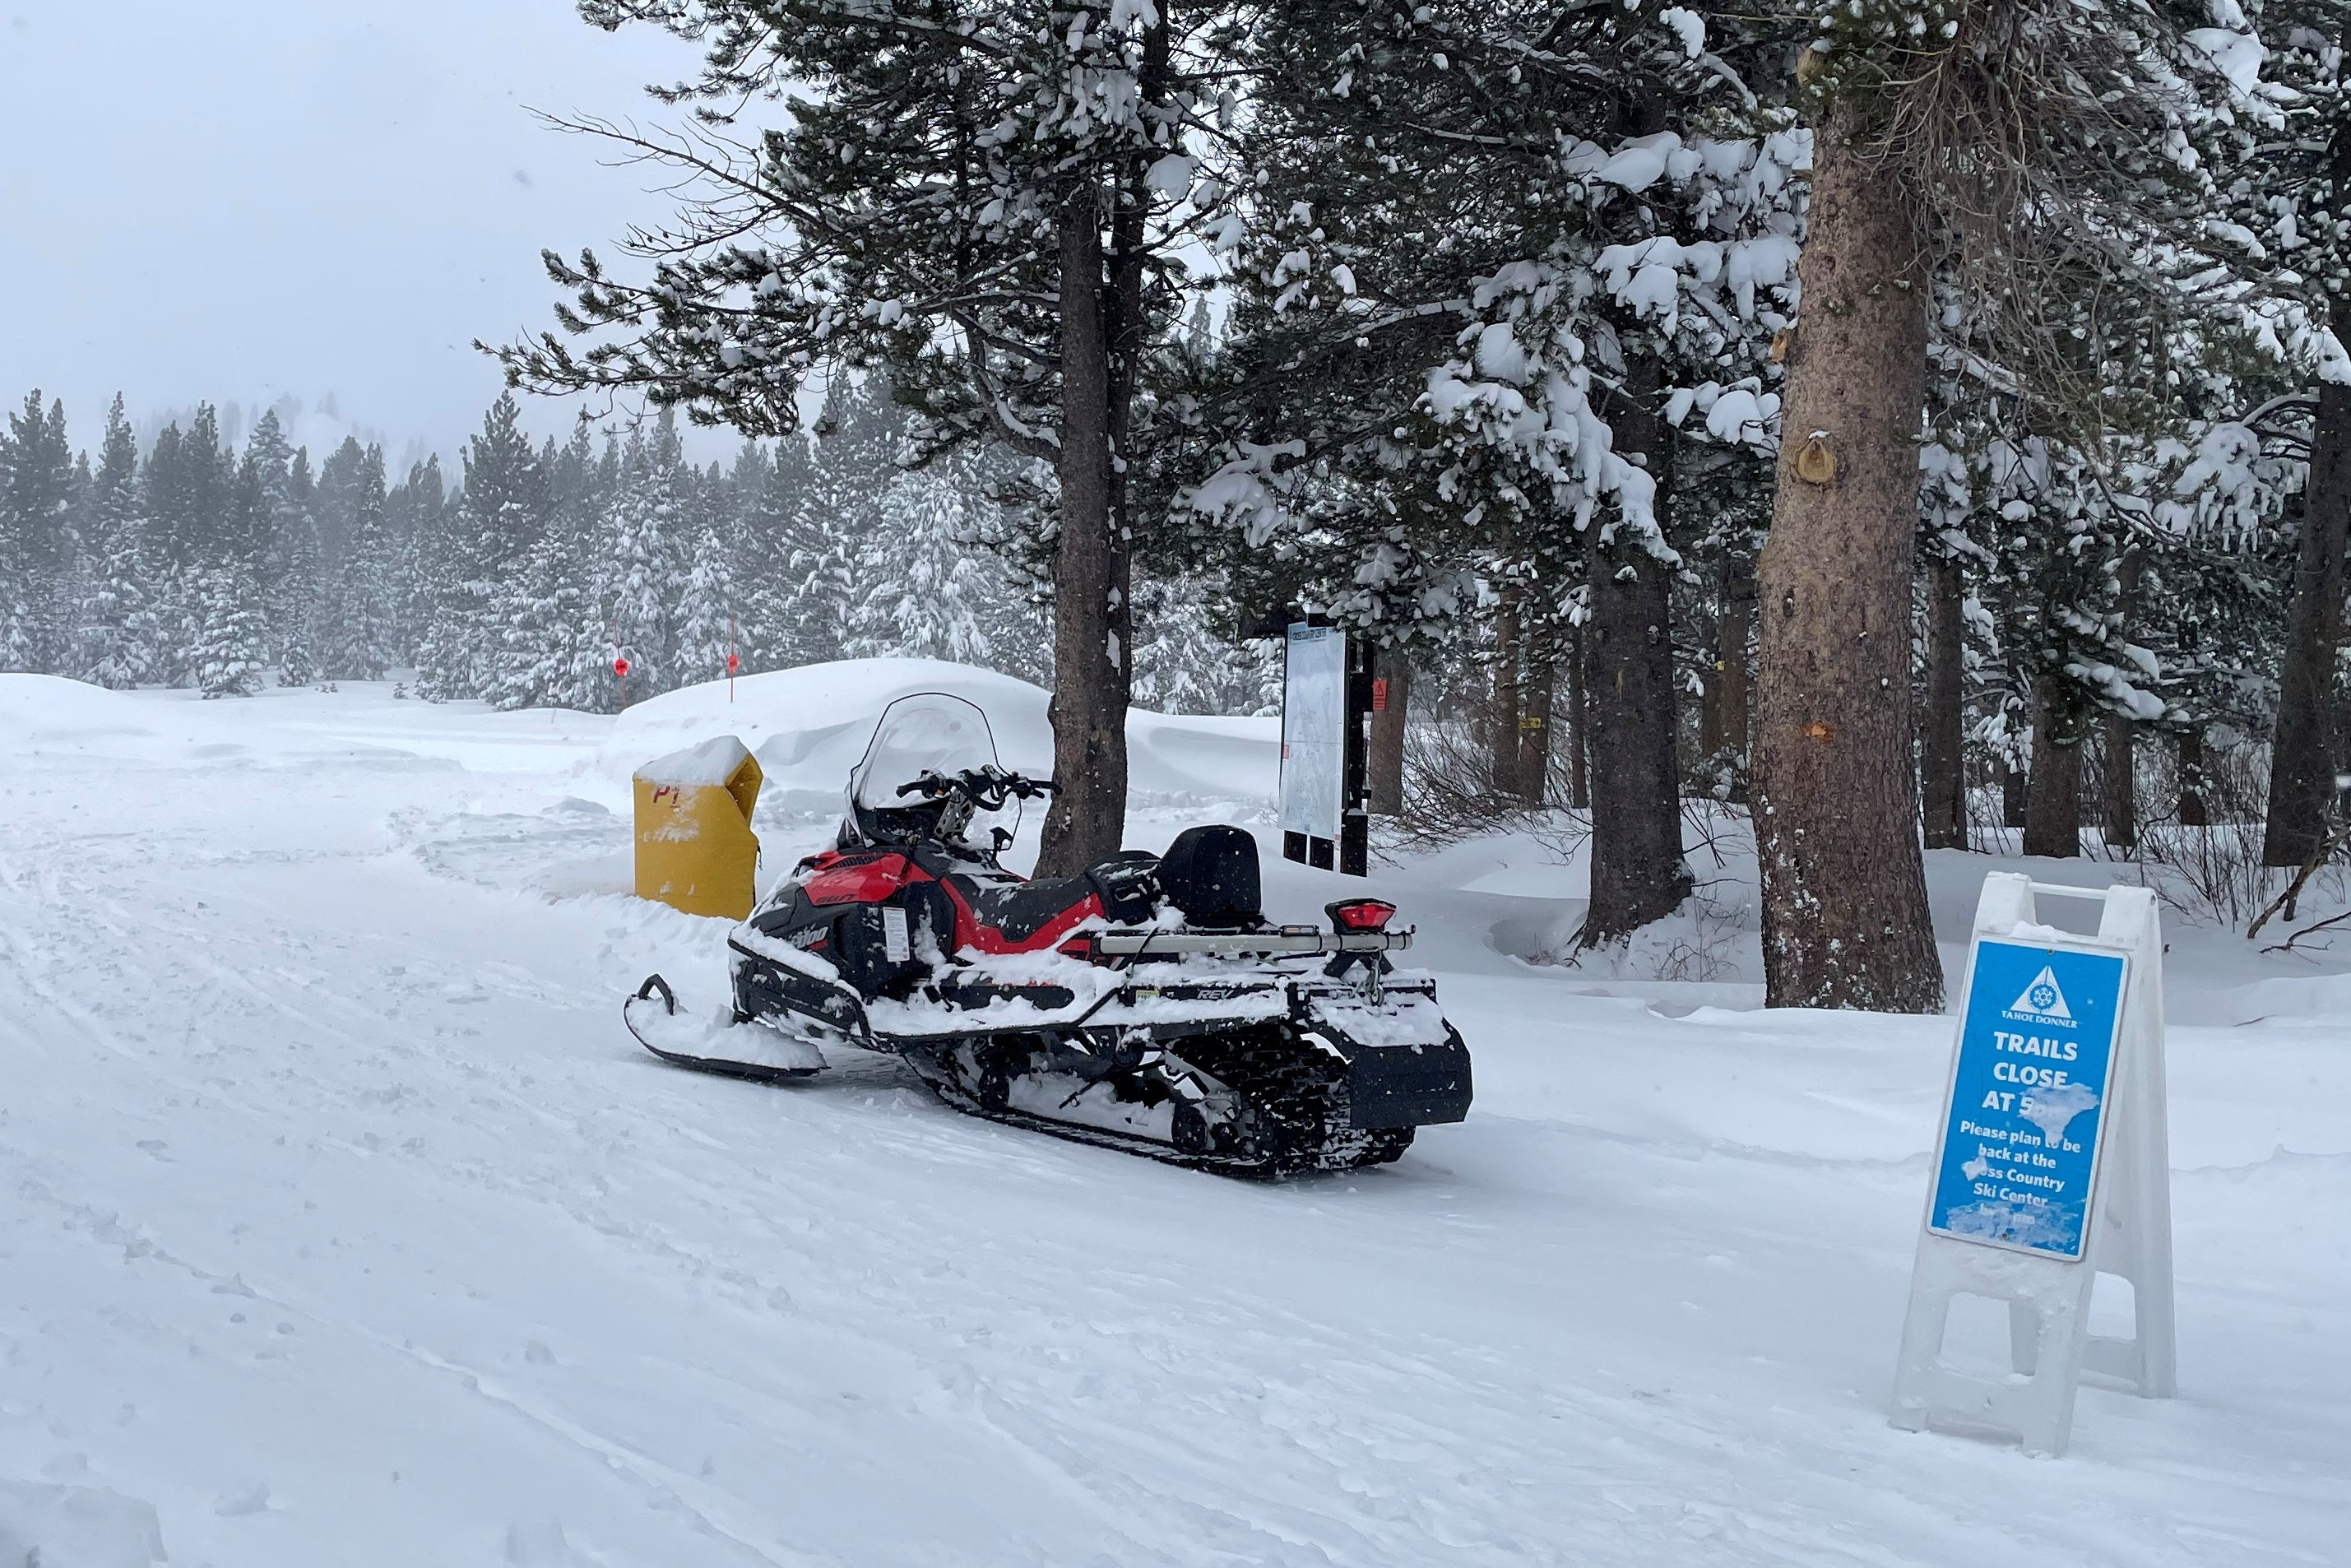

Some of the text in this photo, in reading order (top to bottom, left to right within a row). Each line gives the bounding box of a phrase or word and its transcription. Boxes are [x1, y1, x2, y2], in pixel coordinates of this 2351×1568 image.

[1197, 990, 1234, 1000] REV
[2001, 1010, 2078, 1028] TAHOE DONNER
[1994, 1032, 2078, 1061] TRAILS
[1993, 1062, 2068, 1088] CLOSE
[1982, 1091, 2015, 1112] AT
[1960, 1120, 2007, 1140] Please
[2010, 1130, 2041, 1146] plan
[2063, 1139, 2081, 1153] be
[1978, 1143, 2057, 1169] back at the
[2006, 1168, 2065, 1192] Country
[1973, 1182, 2048, 1207] Ski Center
